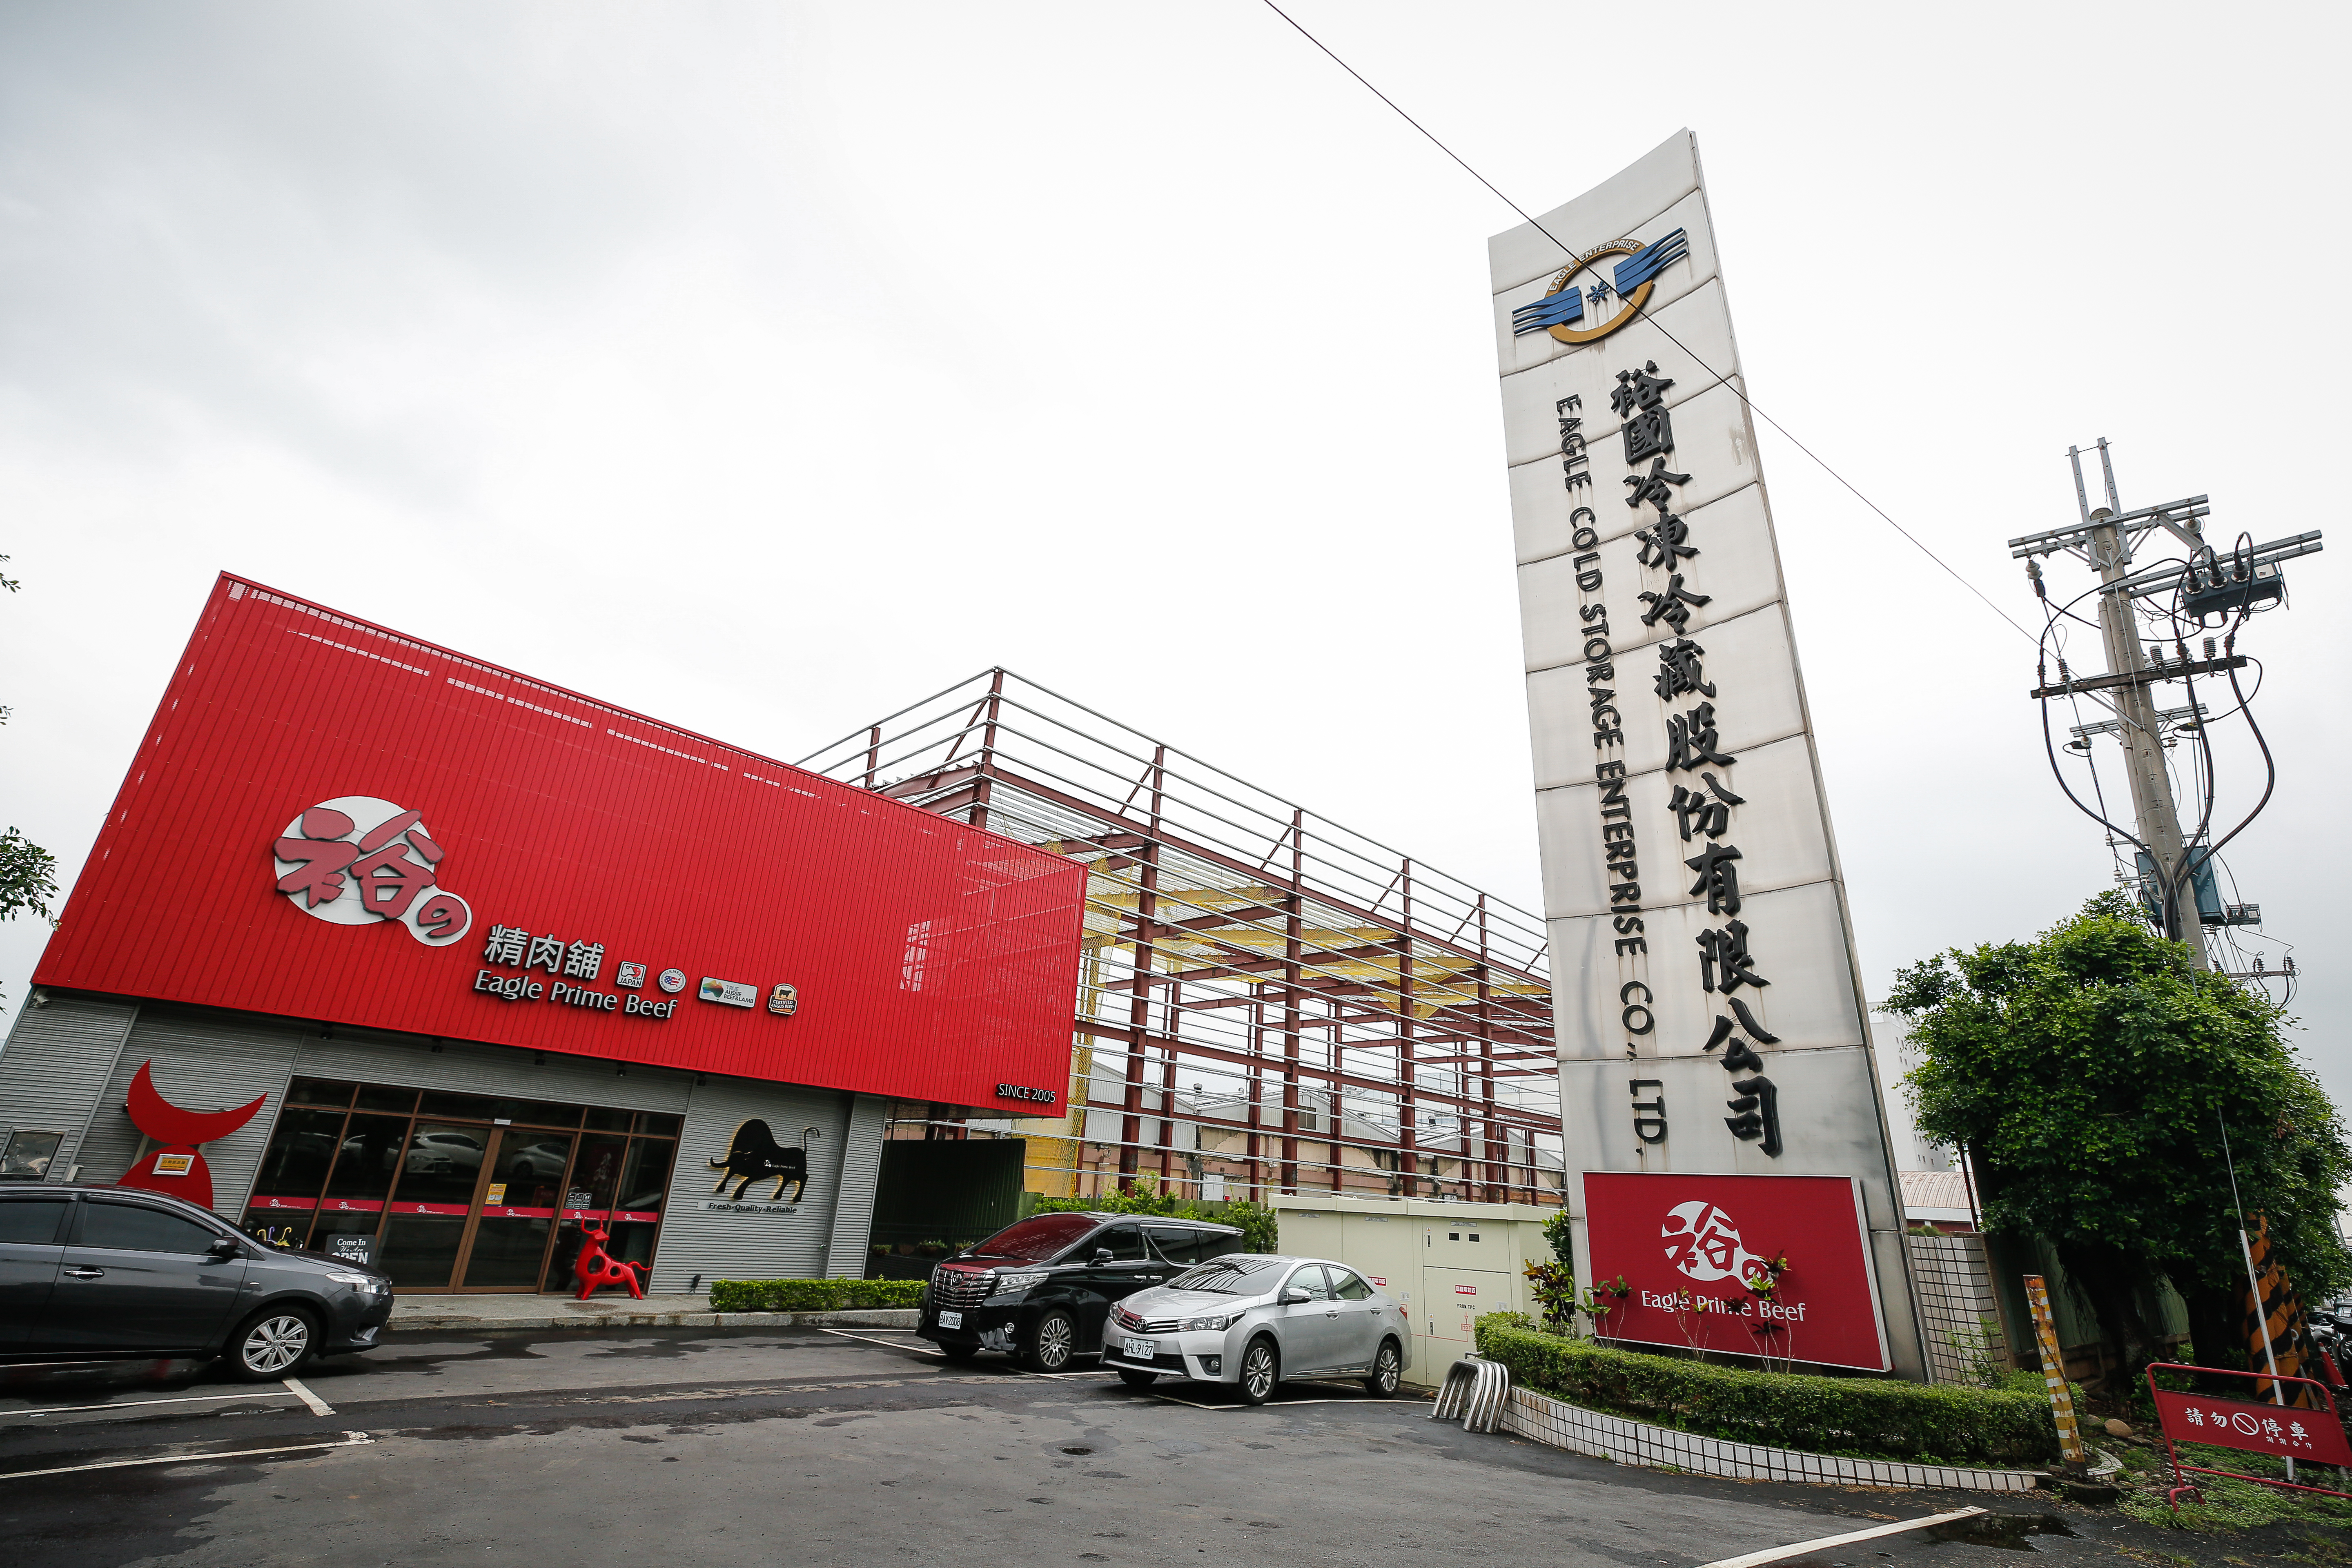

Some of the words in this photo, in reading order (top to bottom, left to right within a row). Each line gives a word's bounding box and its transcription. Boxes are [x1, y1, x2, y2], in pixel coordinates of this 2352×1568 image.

[1549, 261, 1576, 291] EAGLE
[1579, 240, 1640, 261] ENTERPRISE
[1556, 393, 1591, 491] EAGLE
[1569, 507, 1603, 592] COLD
[1579, 604, 1624, 749] STORAGE
[1610, 359, 1784, 1158] 裕國冷凍冷藏股份有限公司
[1595, 759, 1648, 956] ENTERPRISE
[474, 969, 543, 1000] Eagle
[550, 981, 618, 1010] Prime
[625, 994, 678, 1018] Beef
[619, 978, 642, 987] JAPAN
[998, 1083, 1030, 1098] SINCE
[1031, 1088, 1056, 1102] 2005
[1758, 1300, 1806, 1322] Beef
